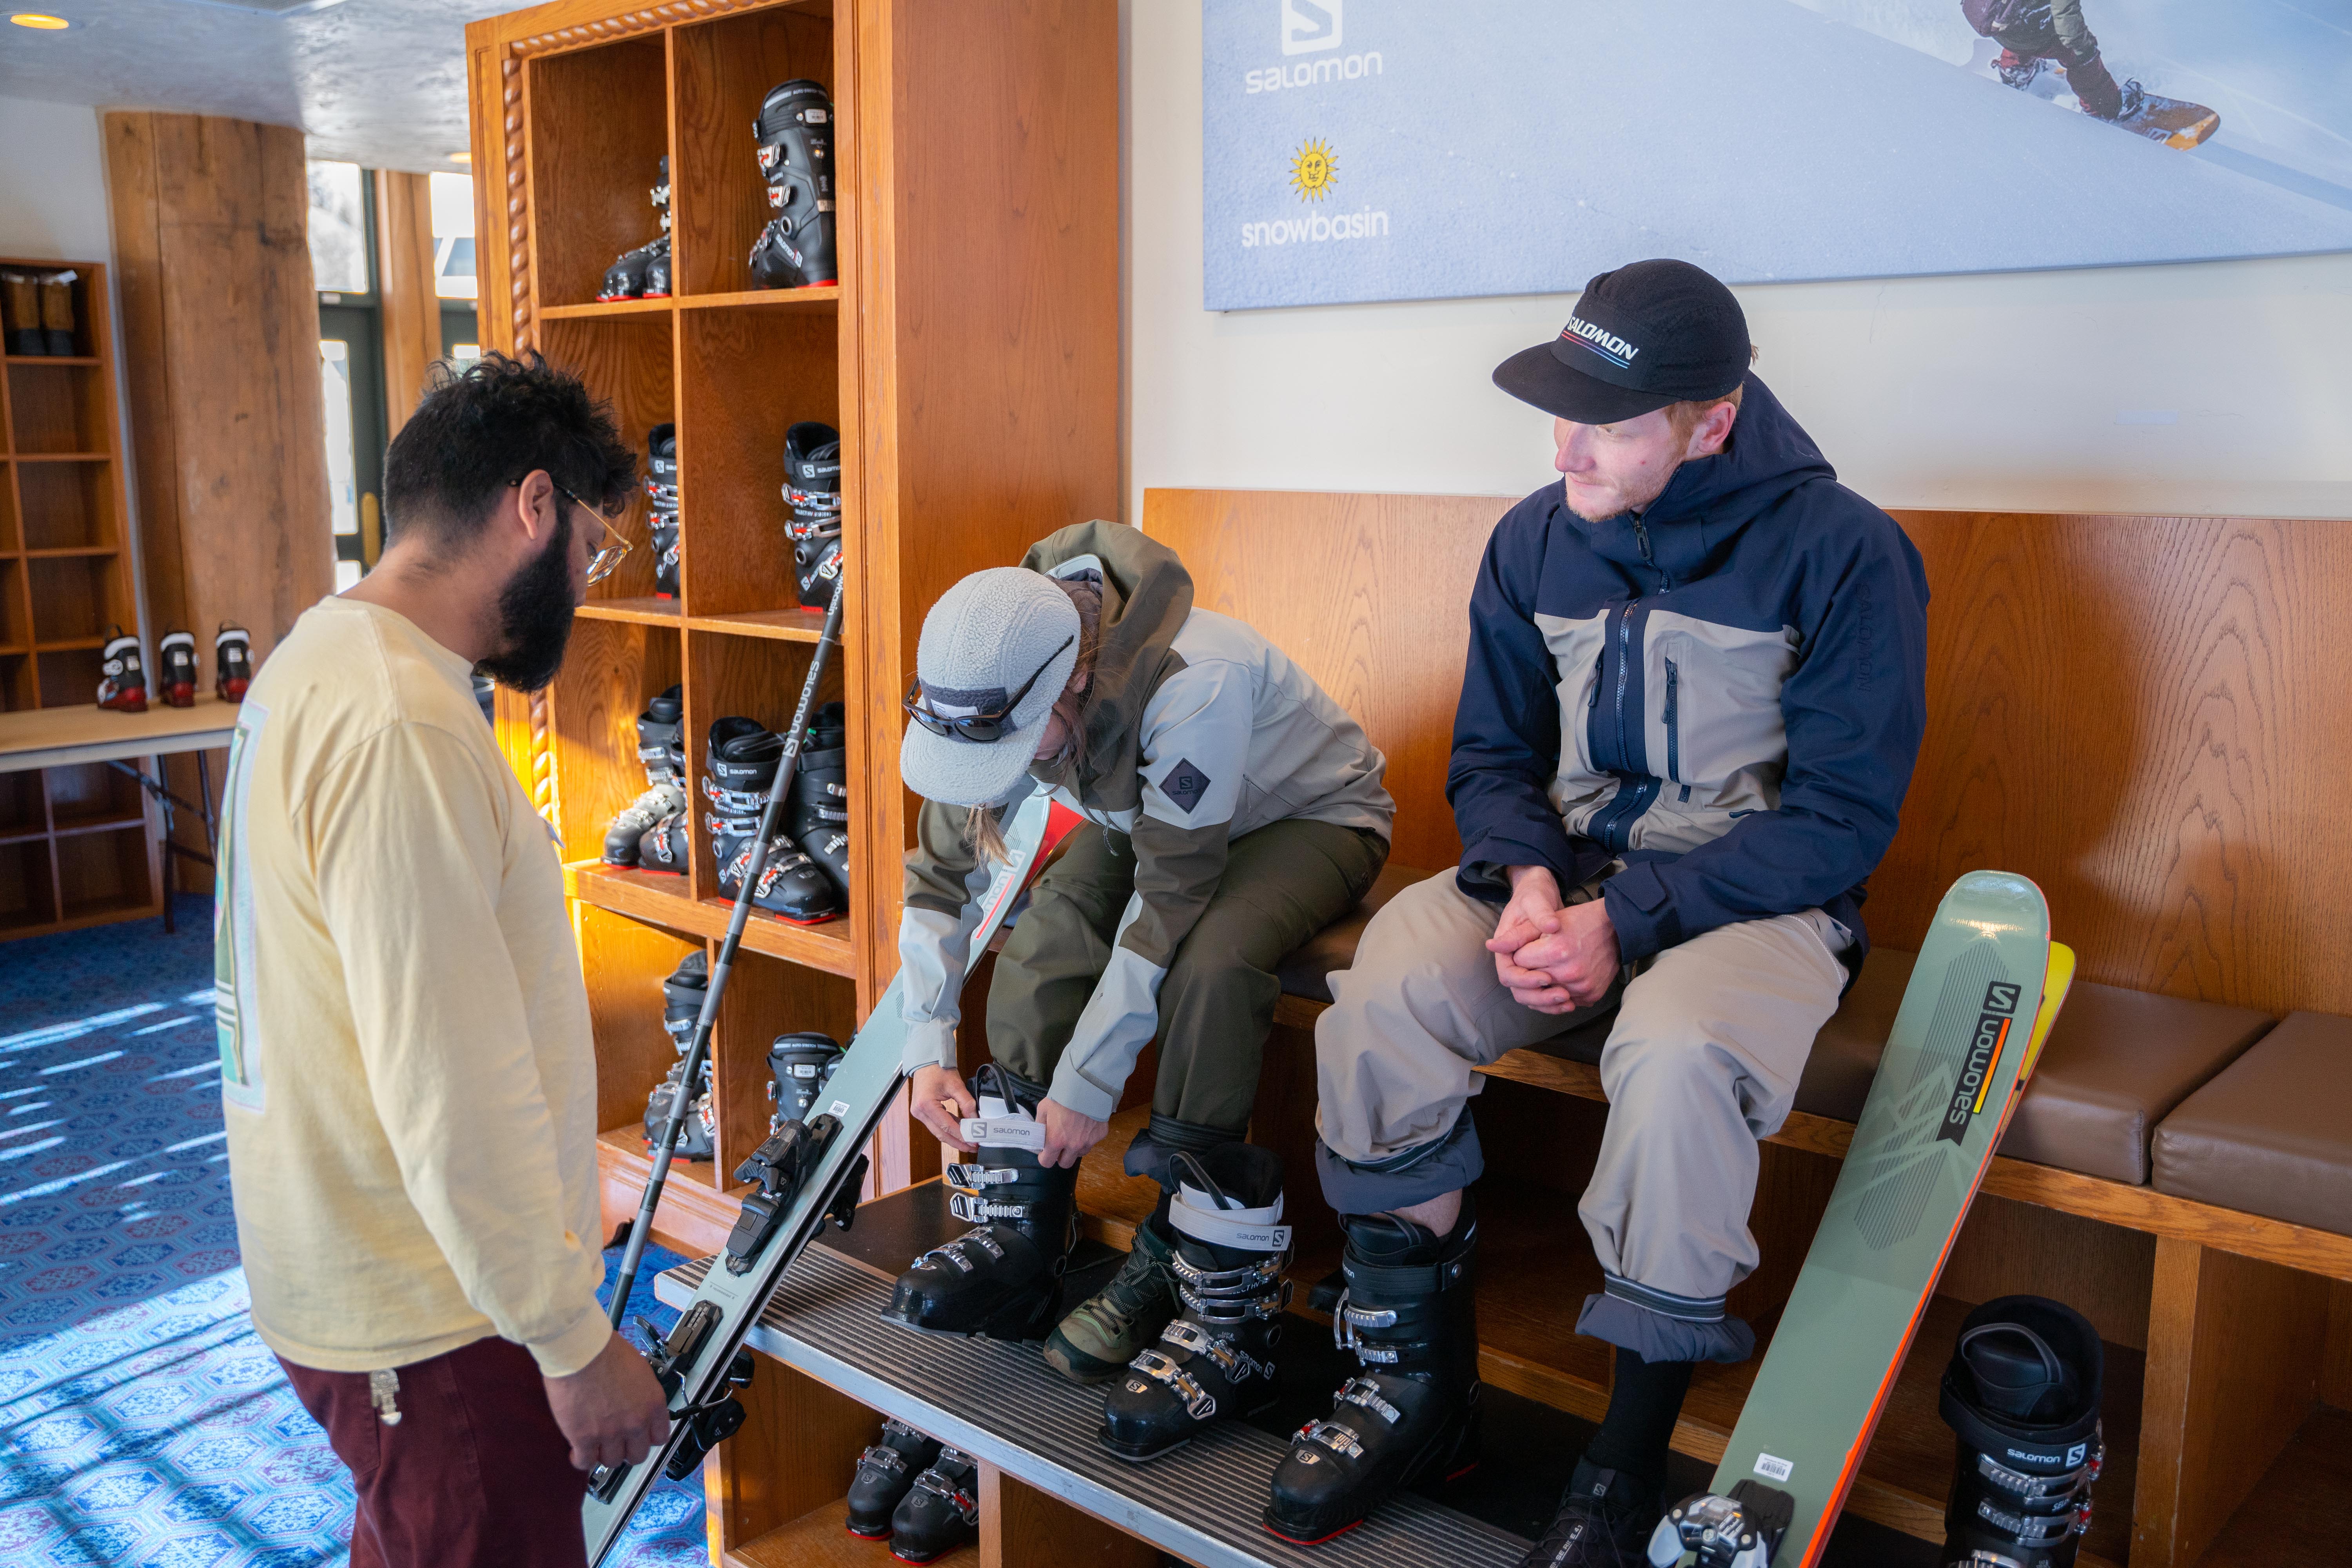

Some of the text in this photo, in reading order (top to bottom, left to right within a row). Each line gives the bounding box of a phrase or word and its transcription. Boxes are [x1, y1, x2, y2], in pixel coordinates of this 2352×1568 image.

[1245, 52, 1383, 94] salomon
[1241, 205, 1389, 247] snowbasin
[1567, 316, 1639, 360] SALOMON
[791, 661, 820, 734] salomon
[1949, 1020, 1998, 1125] salomon
[1236, 1233, 1269, 1241] salomon
[1240, 1350, 1262, 1374] salomon
[2007, 1448, 2060, 1463] salomon
